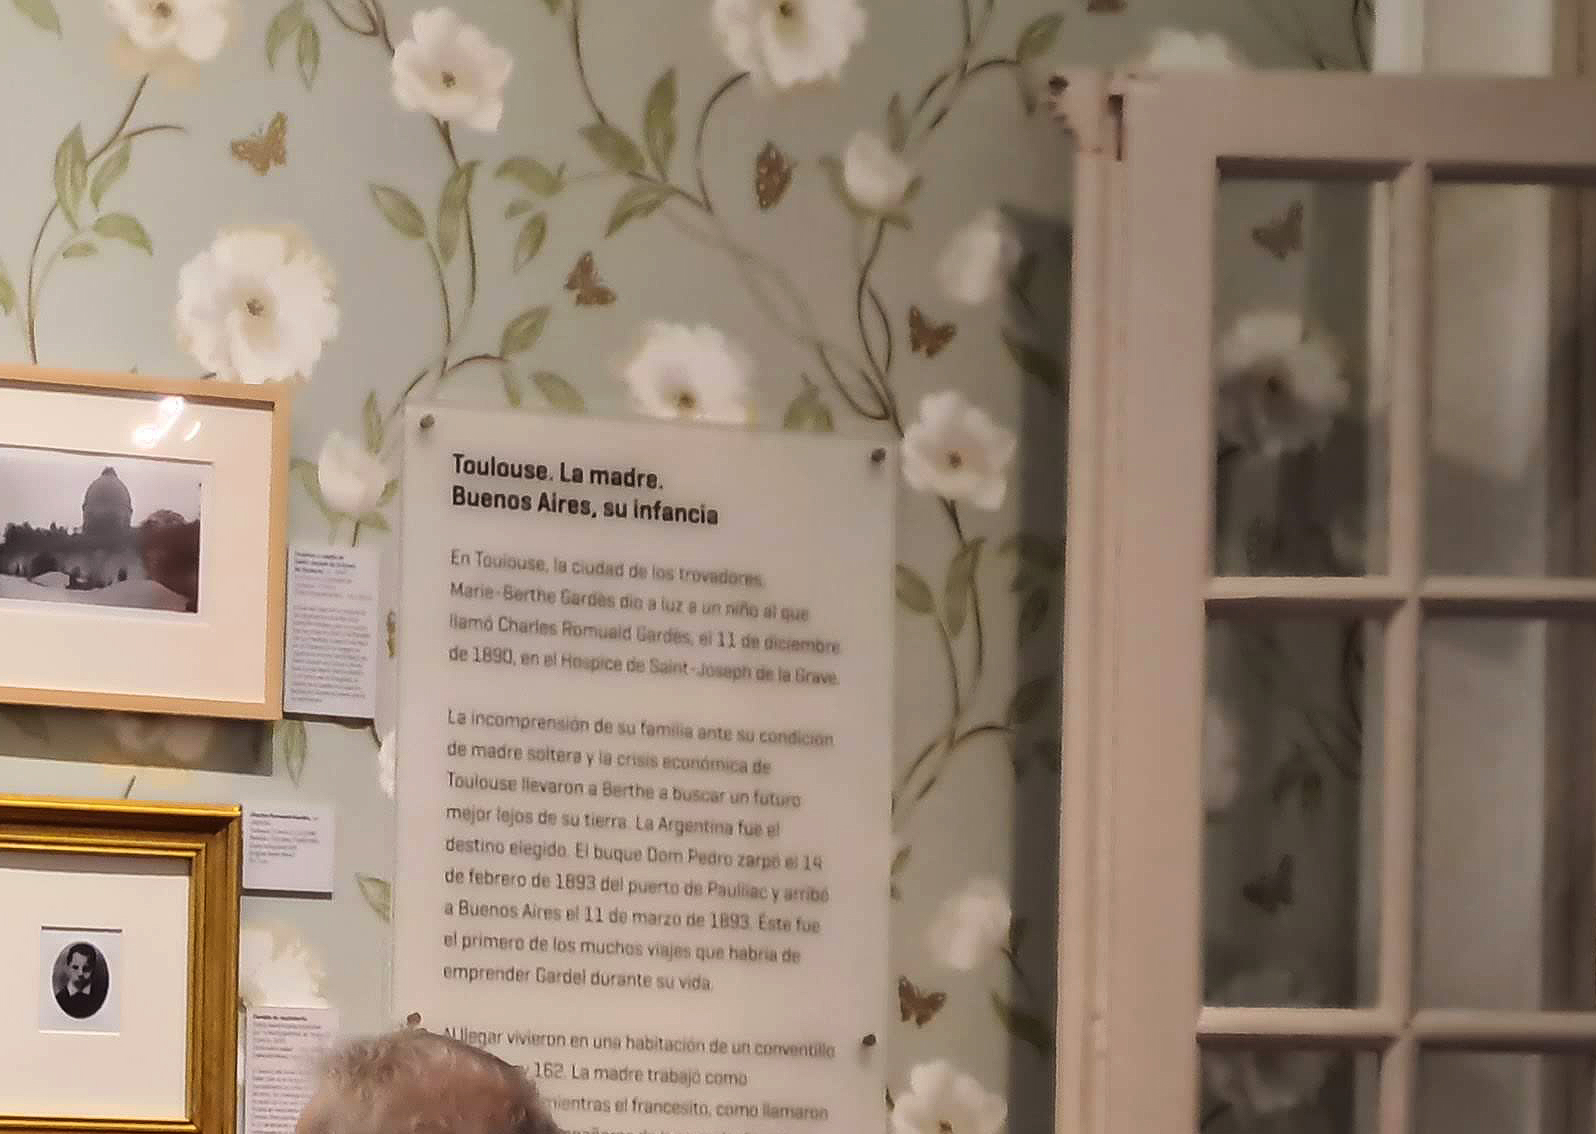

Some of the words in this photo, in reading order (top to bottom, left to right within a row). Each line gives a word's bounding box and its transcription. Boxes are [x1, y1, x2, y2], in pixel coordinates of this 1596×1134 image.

[452, 454, 552, 481] Toulouse.
[560, 462, 582, 483] La
[590, 465, 663, 489] madre.
[452, 486, 531, 511] Buenos
[537, 493, 596, 518] Aires,
[603, 501, 626, 518] su
[634, 500, 717, 524] infancia
[450, 550, 470, 567] En
[474, 552, 549, 574] Toulouse,
[571, 559, 624, 577] ciudad
[628, 563, 647, 579] de
[652, 564, 675, 581] los
[661, 596, 683, 613] luz
[702, 602, 721, 615] un
[725, 601, 758, 618] niño
[780, 607, 808, 625] que
[498, 617, 557, 635] Charles
[562, 621, 631, 640] Romuald
[717, 631, 735, 647] 11
[741, 633, 759, 649] de
[448, 645, 468, 662] de
[520, 653, 539, 666] en
[561, 653, 622, 675] Hospice
[626, 657, 645, 673] de
[756, 666, 774, 682] de
[448, 709, 466, 725] La
[593, 718, 613, 734] de
[617, 722, 636, 735] su
[697, 725, 732, 741] ante
[736, 729, 755, 743] su
[447, 741, 466, 757] de
[471, 742, 522, 760] madre
[527, 745, 582, 764] soltera
[752, 759, 770, 775] de
[447, 772, 516, 791] Toulouse
[521, 776, 583, 795] llevaron
[602, 781, 654, 799] Berthe
[672, 785, 724, 803] buscar
[730, 791, 749, 805] un
[754, 790, 801, 808] futuro
[446, 806, 491, 825] mejor
[496, 806, 533, 827] lejos
[538, 809, 557, 825] de
[562, 813, 580, 826] su
[635, 814, 653, 830] La
[657, 816, 733, 839] Argentina
[737, 820, 763, 837] fue
[445, 836, 504, 854] destino
[593, 844, 642, 866] buque
[688, 850, 732, 867] Pedro
[803, 856, 822, 872] 14
[444, 868, 464, 884] de
[468, 869, 526, 887] febrero
[531, 872, 550, 889] de
[556, 874, 595, 891] 1893
[600, 876, 623, 893] del
[628, 879, 679, 899] puerto
[684, 881, 702, 897] de
[458, 900, 517, 918] Buenos
[522, 903, 561, 920] Aires
[585, 906, 603, 922] 11
[608, 908, 627, 924] de
[632, 912, 681, 927] marzo
[686, 912, 704, 928] de
[795, 918, 820, 934] fue
[461, 932, 524, 954] primero
[528, 935, 548, 951] de
[553, 936, 575, 953] los
[580, 938, 642, 956] muchos
[646, 942, 691, 962] viajes
[695, 946, 724, 964] que
[781, 948, 800, 964] de
[443, 962, 530, 985] emprender
[535, 967, 586, 984] Gardel
[590, 970, 652, 988] durante
[657, 976, 675, 989] su
[506, 1029, 566, 1047] vivieron
[570, 1034, 588, 1048] en
[593, 1035, 621, 1049] una
[709, 1038, 727, 1054] de
[732, 1042, 750, 1055] un
[572, 1064, 589, 1080] La
[594, 1065, 643, 1082] madre
[704, 1073, 747, 1087] como
[716, 1104, 758, 1118] como
